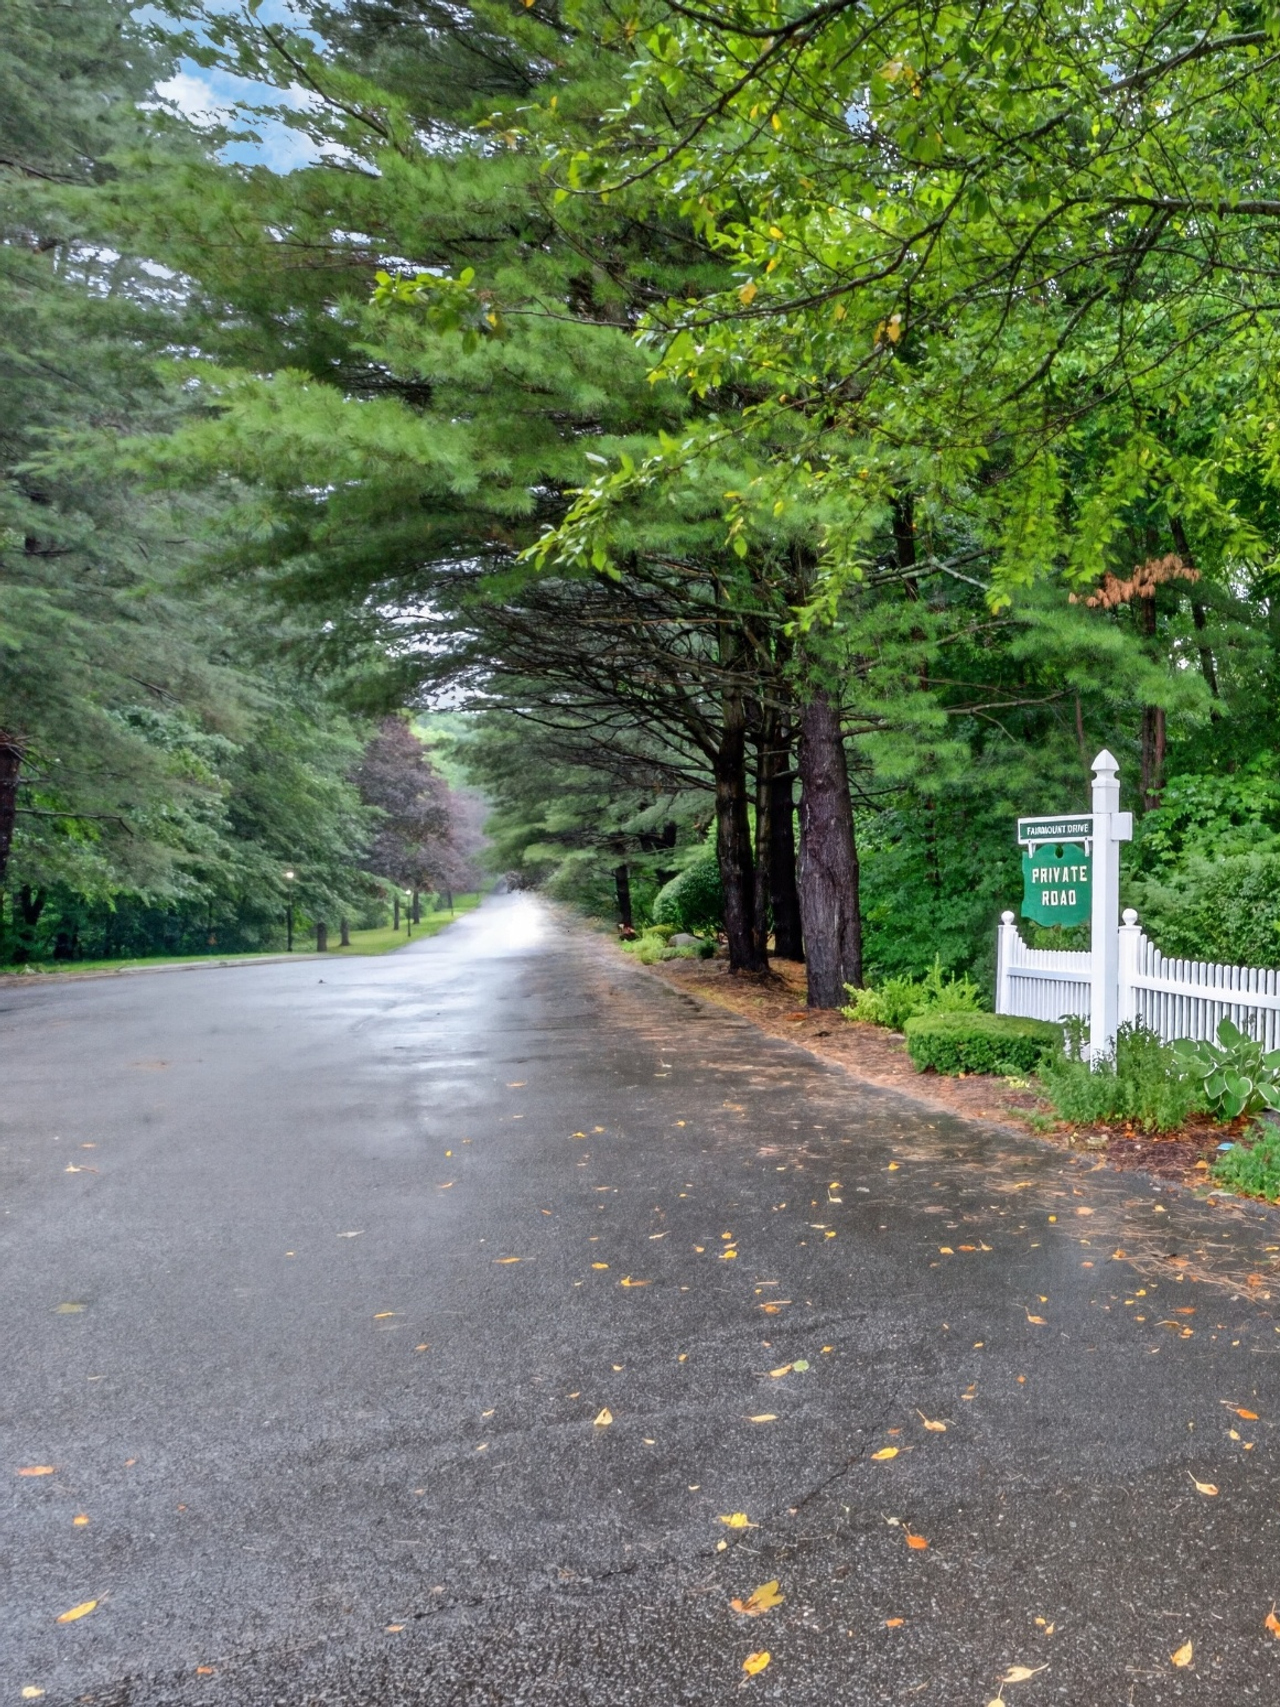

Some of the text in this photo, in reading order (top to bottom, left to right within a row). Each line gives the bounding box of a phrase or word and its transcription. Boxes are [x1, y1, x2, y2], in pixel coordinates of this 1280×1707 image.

[1027, 823, 1089, 836] FAIRMOUNT DRIVE
[1032, 865, 1088, 884] PRIVATE
[1042, 889, 1077, 906] ROAD
